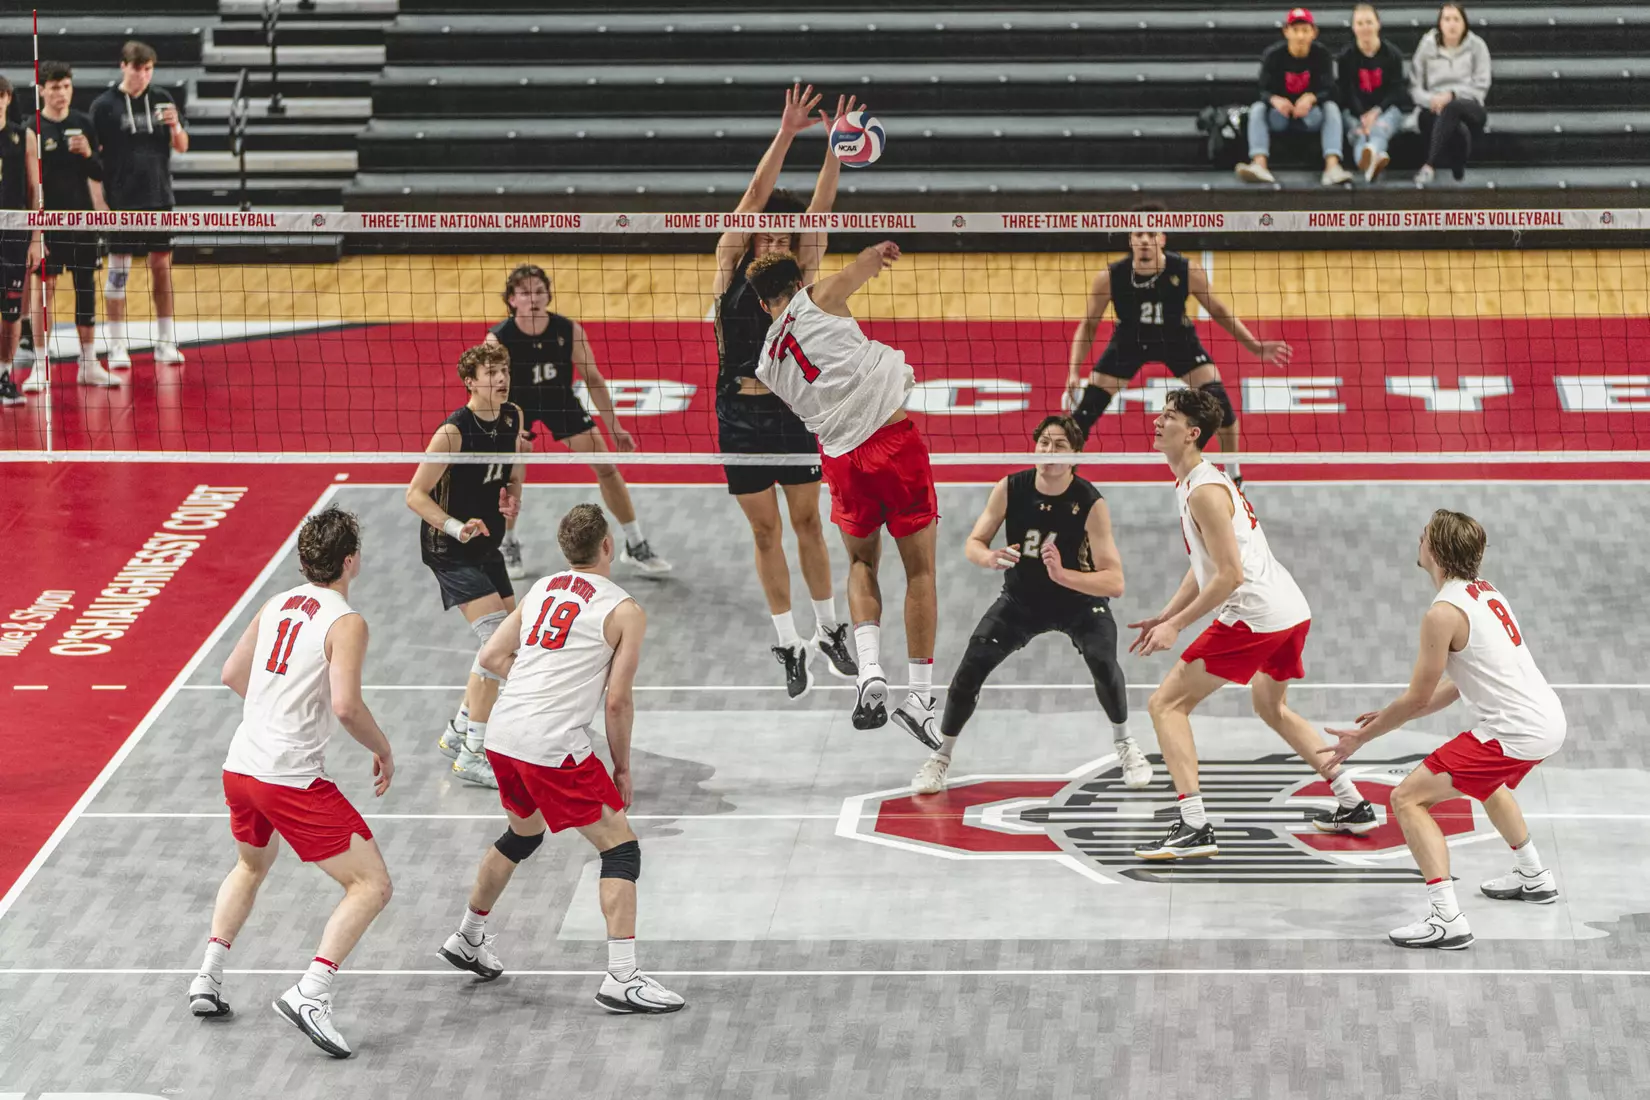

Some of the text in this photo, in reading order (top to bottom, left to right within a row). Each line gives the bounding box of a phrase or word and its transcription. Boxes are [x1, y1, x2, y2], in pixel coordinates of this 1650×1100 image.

[27, 212, 276, 228] HOME OF OHIO STATE MEN'S VOLLEYBALL
[361, 214, 581, 229] THREE-TIME NATIONAL CHAMPIONS
[665, 214, 916, 229] HOME OF OHIO STATE MEN'S VOLLEYBALL
[1002, 214, 1224, 228] THREE-TIME NATIONAL CHAMPIONS
[1309, 211, 1564, 227] HOME OF OHIO STATE MEN'S VOLLEYBALL
[1140, 301, 1164, 324] 21
[532, 363, 557, 385] 16
[572, 376, 1650, 416] BCEYE
[49, 484, 249, 656] O'SHAUGHNESSY COURT
[525, 596, 581, 650] 19
[1487, 598, 1521, 647] 8
[265, 617, 303, 676] 11
